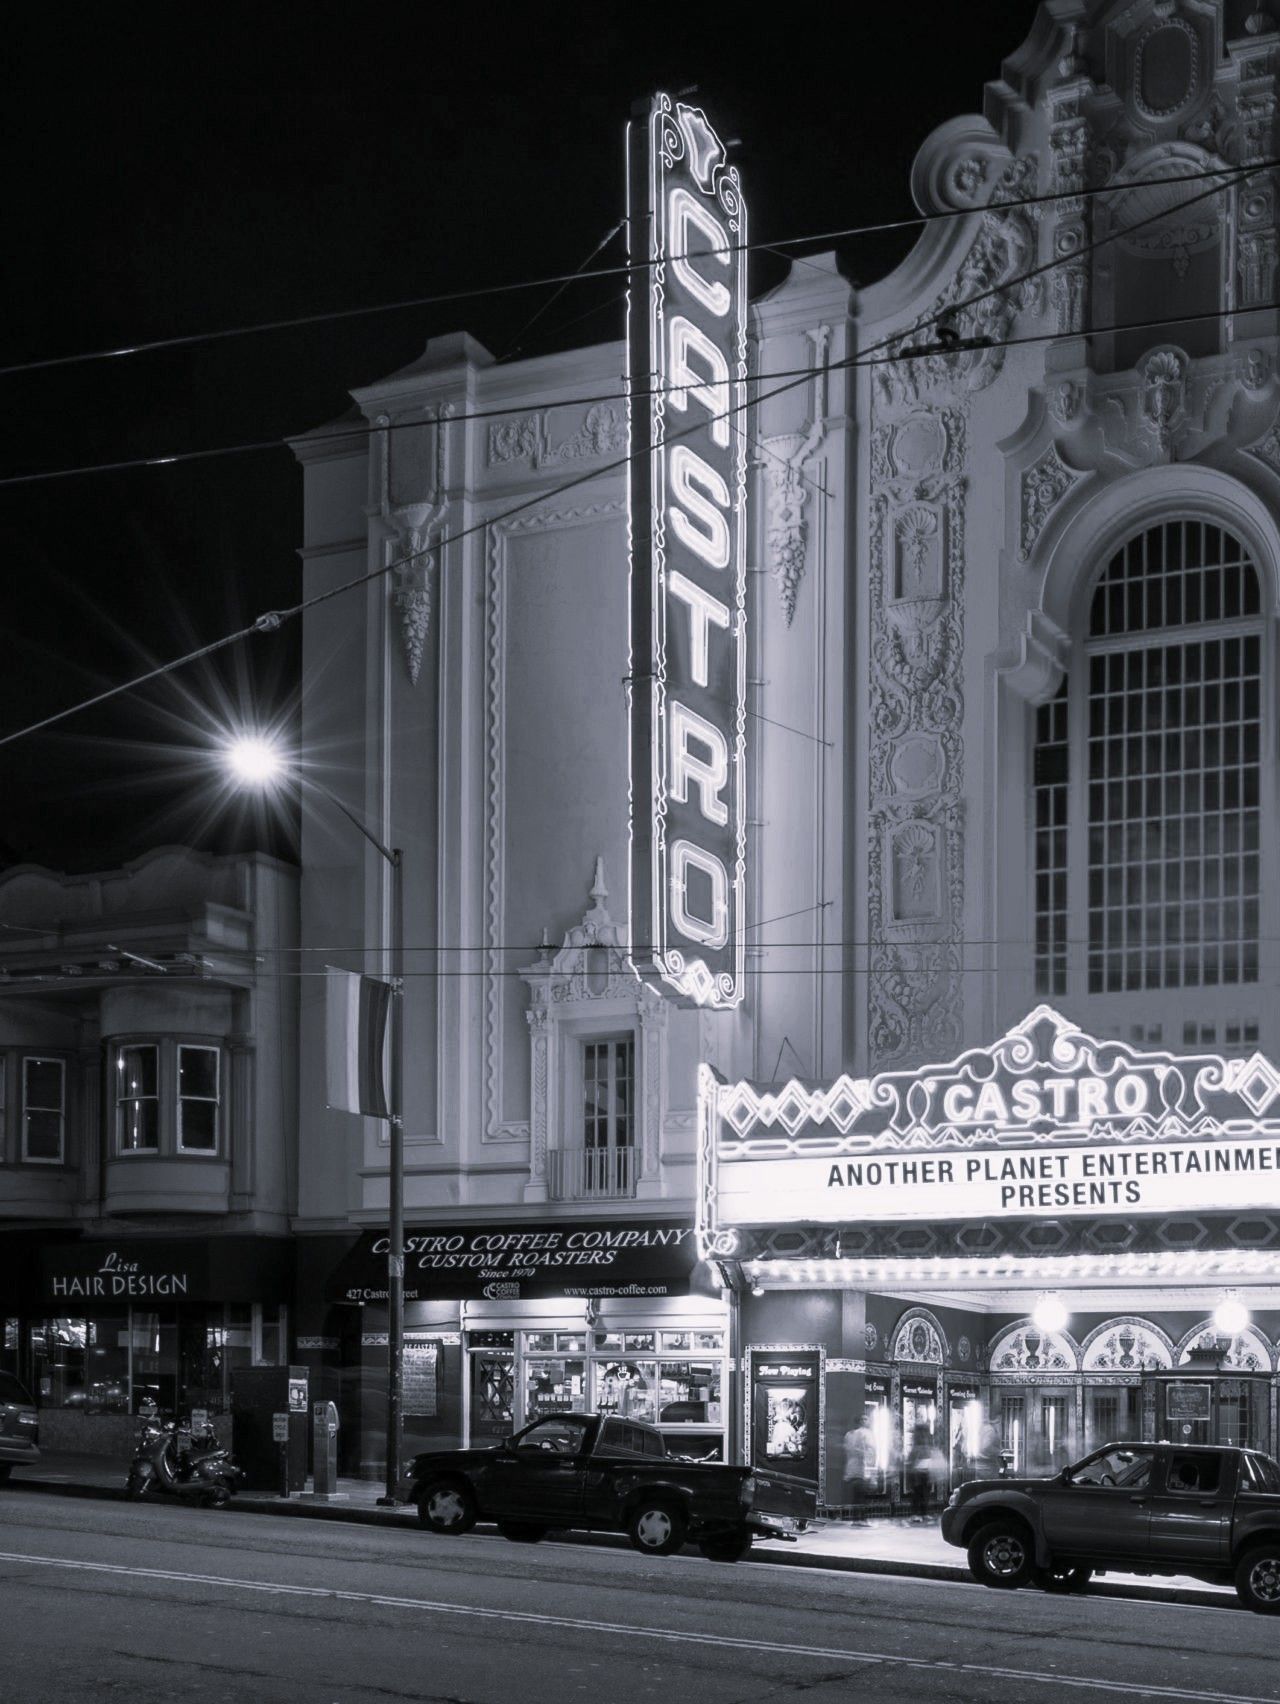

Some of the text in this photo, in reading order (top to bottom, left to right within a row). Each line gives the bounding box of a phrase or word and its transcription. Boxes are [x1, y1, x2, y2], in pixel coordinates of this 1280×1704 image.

[669, 187, 731, 950] CASTRO
[943, 1074, 1148, 1122] CASTRO
[827, 1159, 955, 1188] ANOTHER
[966, 1154, 1070, 1182] PLANET
[1001, 1179, 1141, 1208] PRESENTS
[371, 1228, 693, 1254] CSTRO COFFEE COMPANY
[98, 1252, 139, 1273] Lisa
[418, 1250, 617, 1269] CUSTOM ROASTERS
[477, 1267, 537, 1279] Since 1970
[53, 1274, 188, 1296] HAIR DESIGN
[346, 1288, 363, 1300] 427
[496, 1281, 521, 1289] CASTRO
[563, 1283, 668, 1297] www.castro-coffee.com
[779, 1365, 812, 1377] Playing
